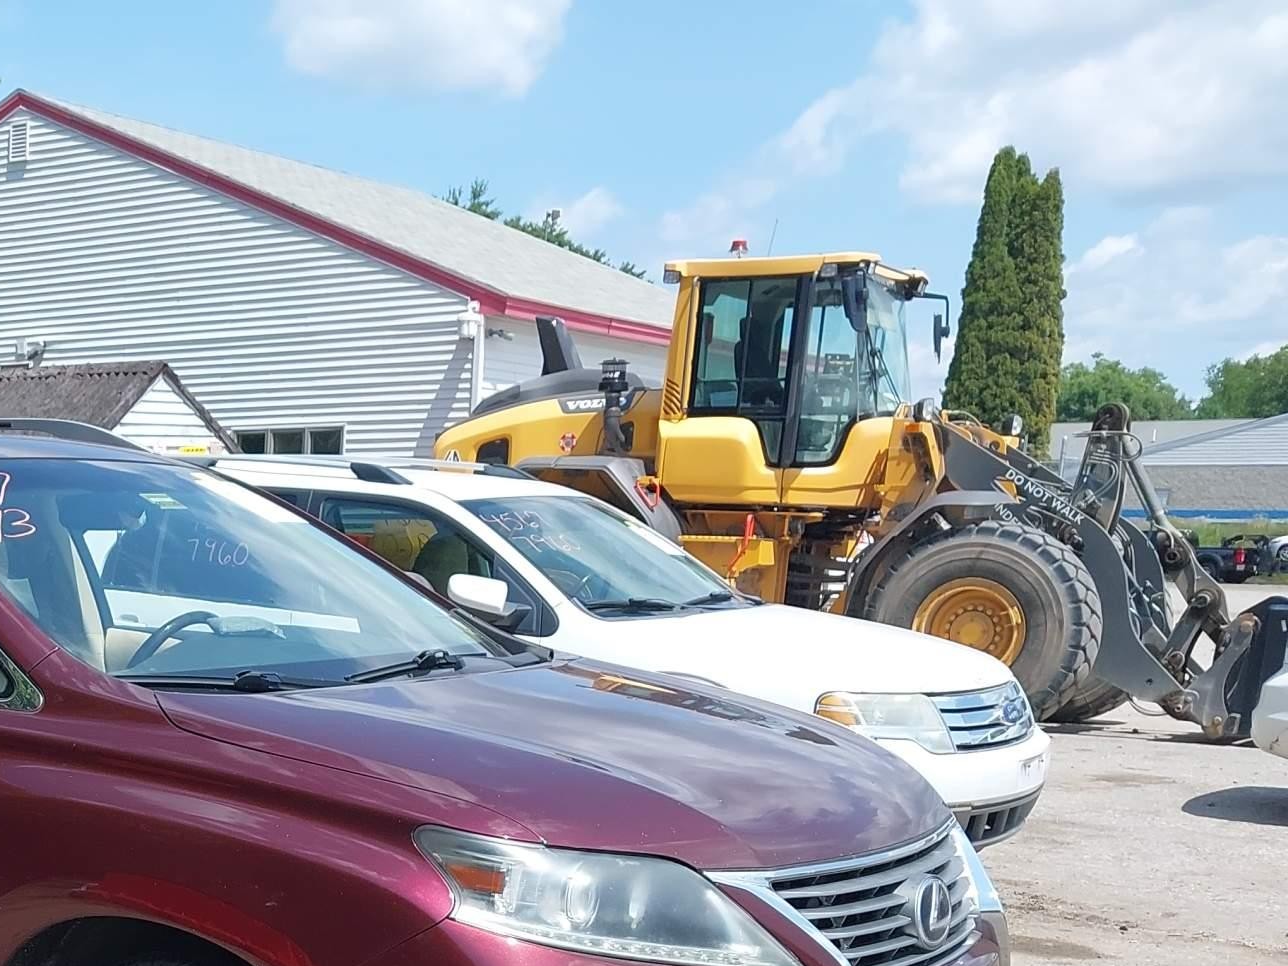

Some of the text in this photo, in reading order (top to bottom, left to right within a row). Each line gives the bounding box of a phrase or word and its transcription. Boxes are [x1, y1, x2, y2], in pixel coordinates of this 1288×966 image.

[1005, 469, 1084, 525] DO NOT WALK
[188, 538, 249, 566] 7960
